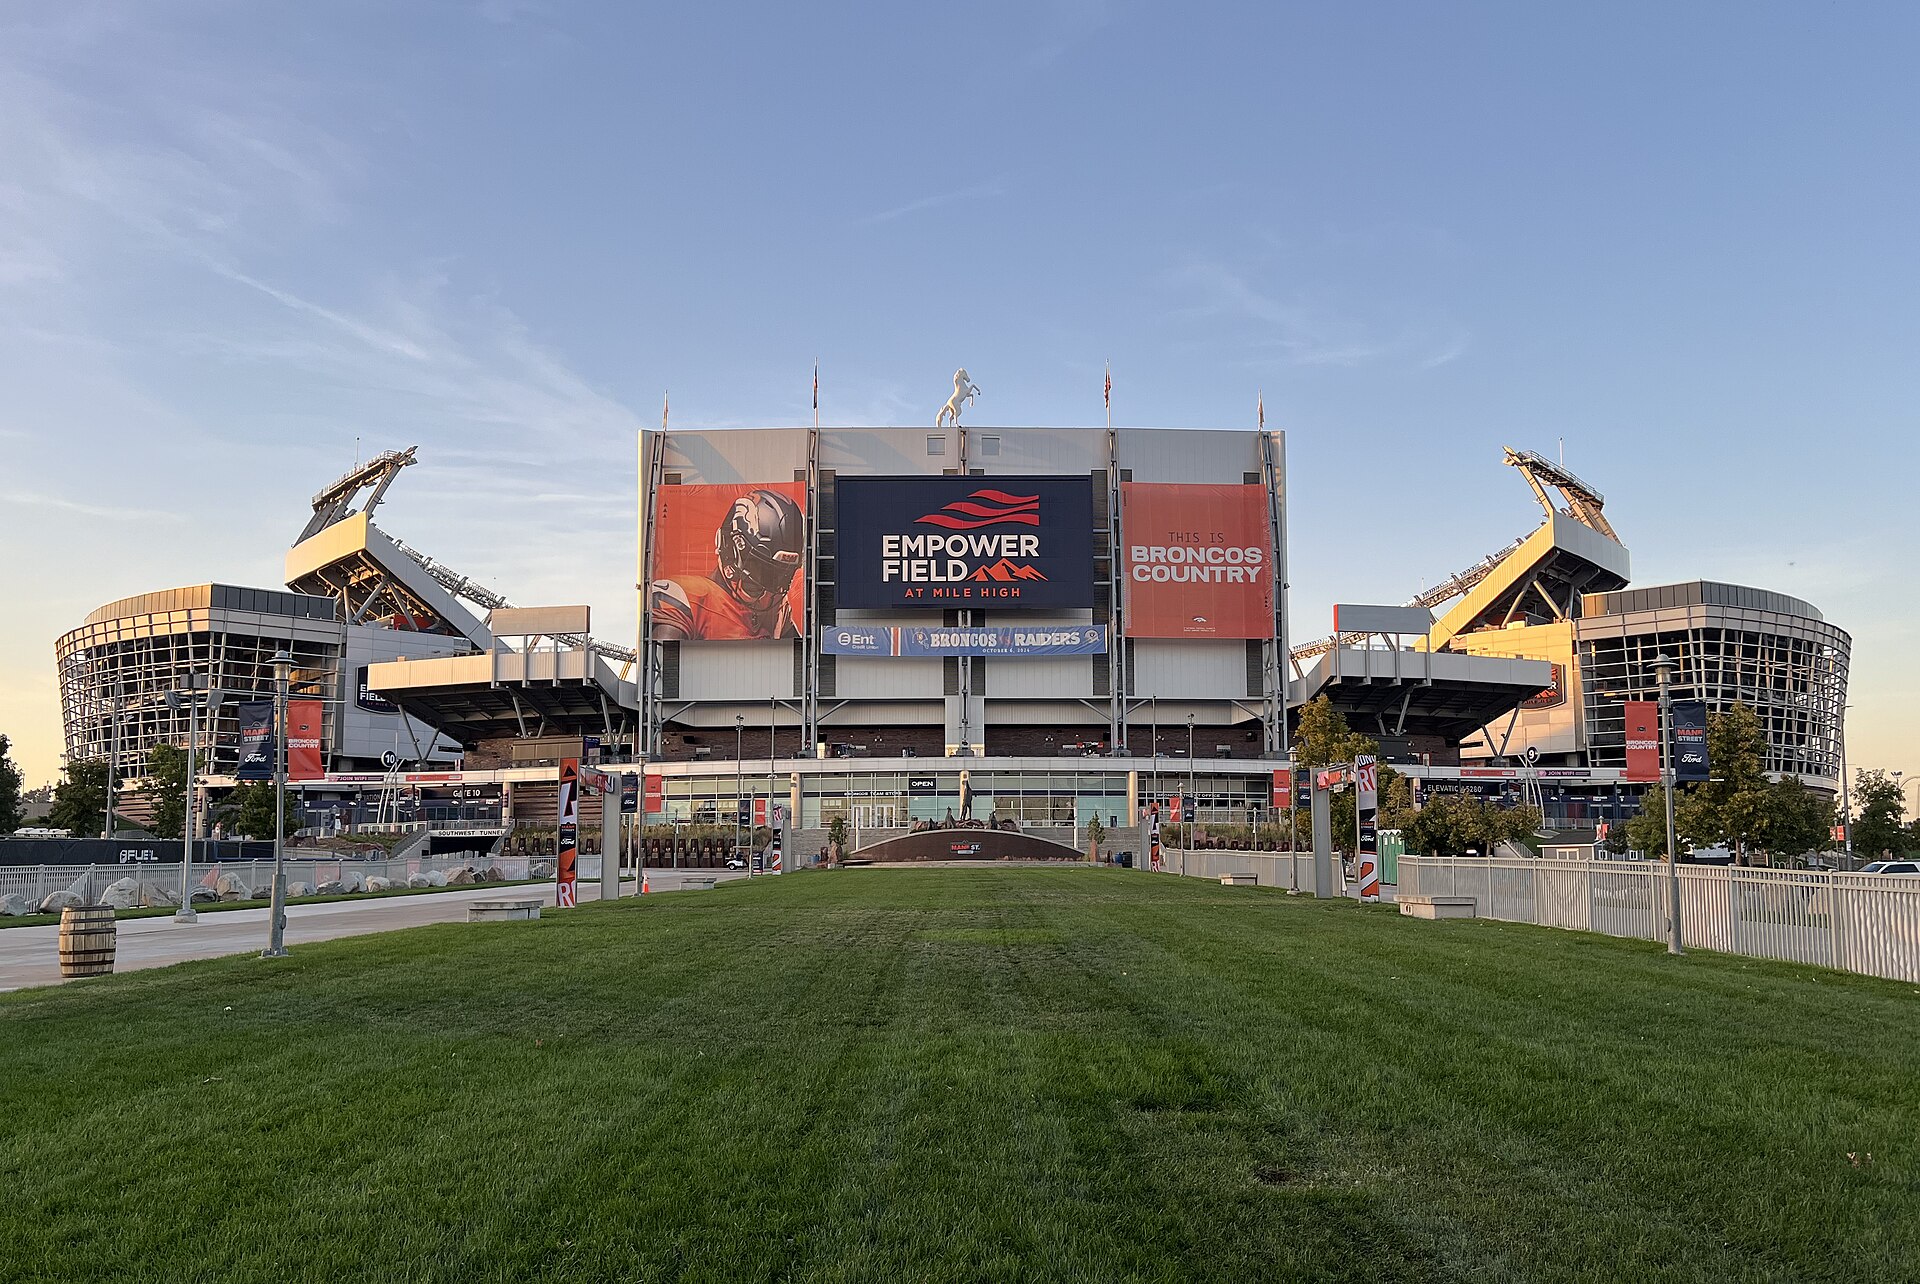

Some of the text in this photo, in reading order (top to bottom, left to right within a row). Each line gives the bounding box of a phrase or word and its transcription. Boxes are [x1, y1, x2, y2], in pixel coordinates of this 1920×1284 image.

[1168, 532, 1225, 543] THIS IS
[882, 534, 1040, 558] EMPOWER
[1131, 545, 1263, 564] BRONCOS
[882, 559, 968, 582] FIELD
[1132, 564, 1262, 583] COUNTRY
[904, 588, 1021, 598] AT MILE HIGH
[852, 634, 874, 645] Ent
[930, 633, 997, 647] BRONCOS
[1014, 632, 1081, 647] RAIDERS
[244, 753, 267, 763] Ford
[385, 754, 395, 763] 10
[1528, 751, 1535, 759] 9
[1681, 753, 1703, 763] Ford
[472, 789, 481, 797] 10
[128, 849, 159, 860] FUEL
